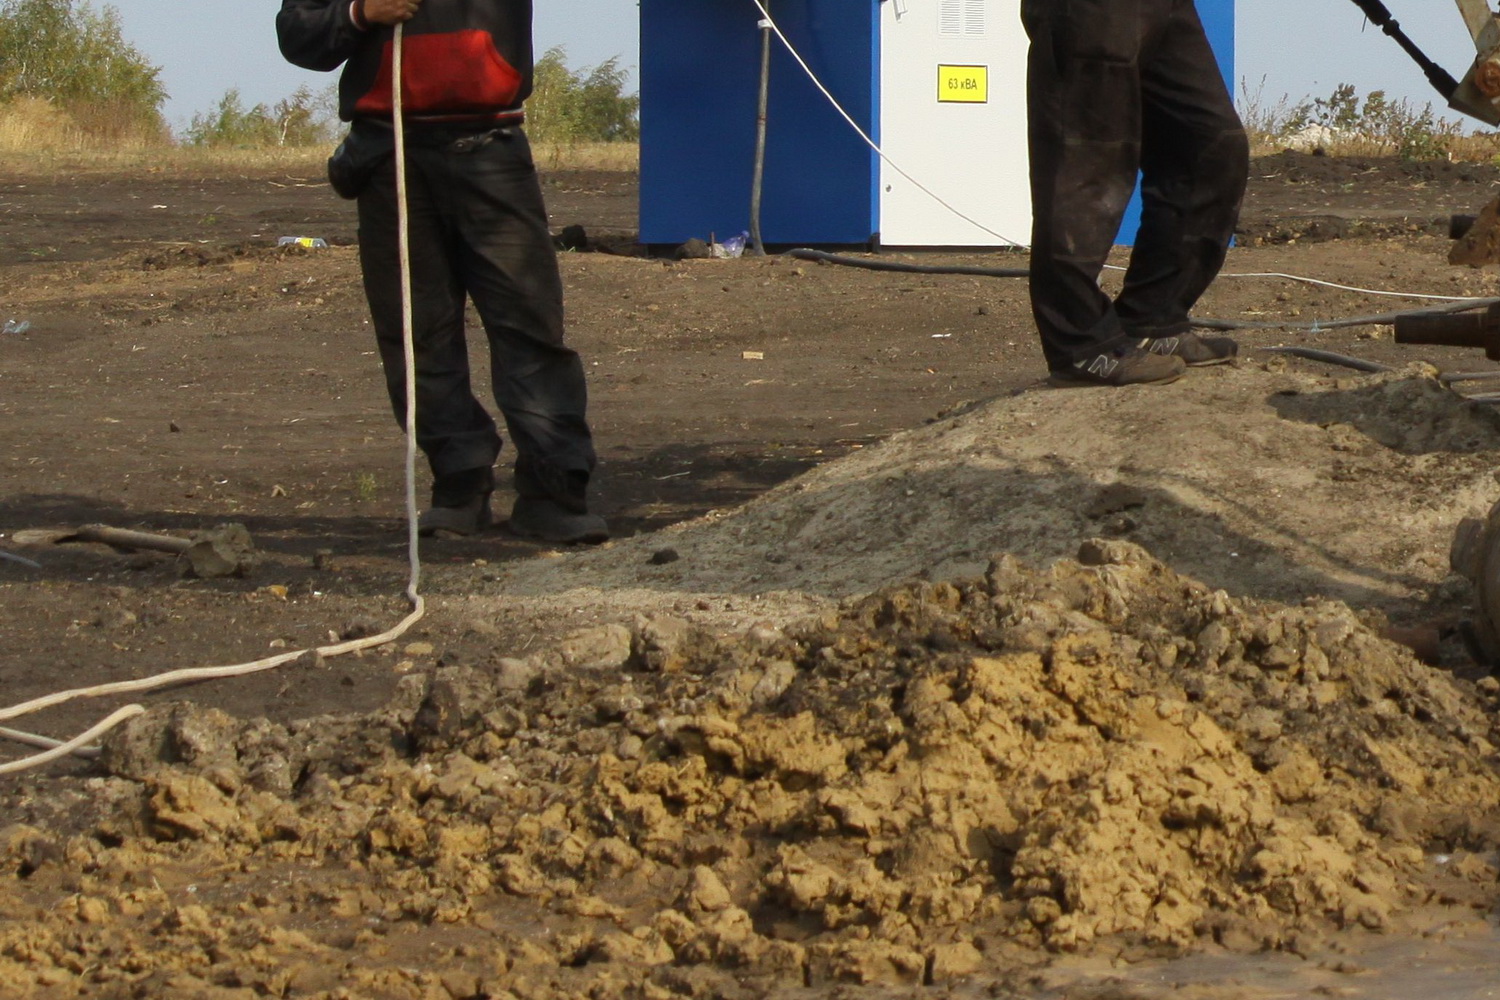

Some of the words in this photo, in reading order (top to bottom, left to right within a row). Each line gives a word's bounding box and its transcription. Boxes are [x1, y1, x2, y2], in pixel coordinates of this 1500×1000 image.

[948, 78, 958, 90] 63
[961, 78, 978, 90] кВА
[1149, 337, 1179, 355] N
[1087, 354, 1119, 378] N
